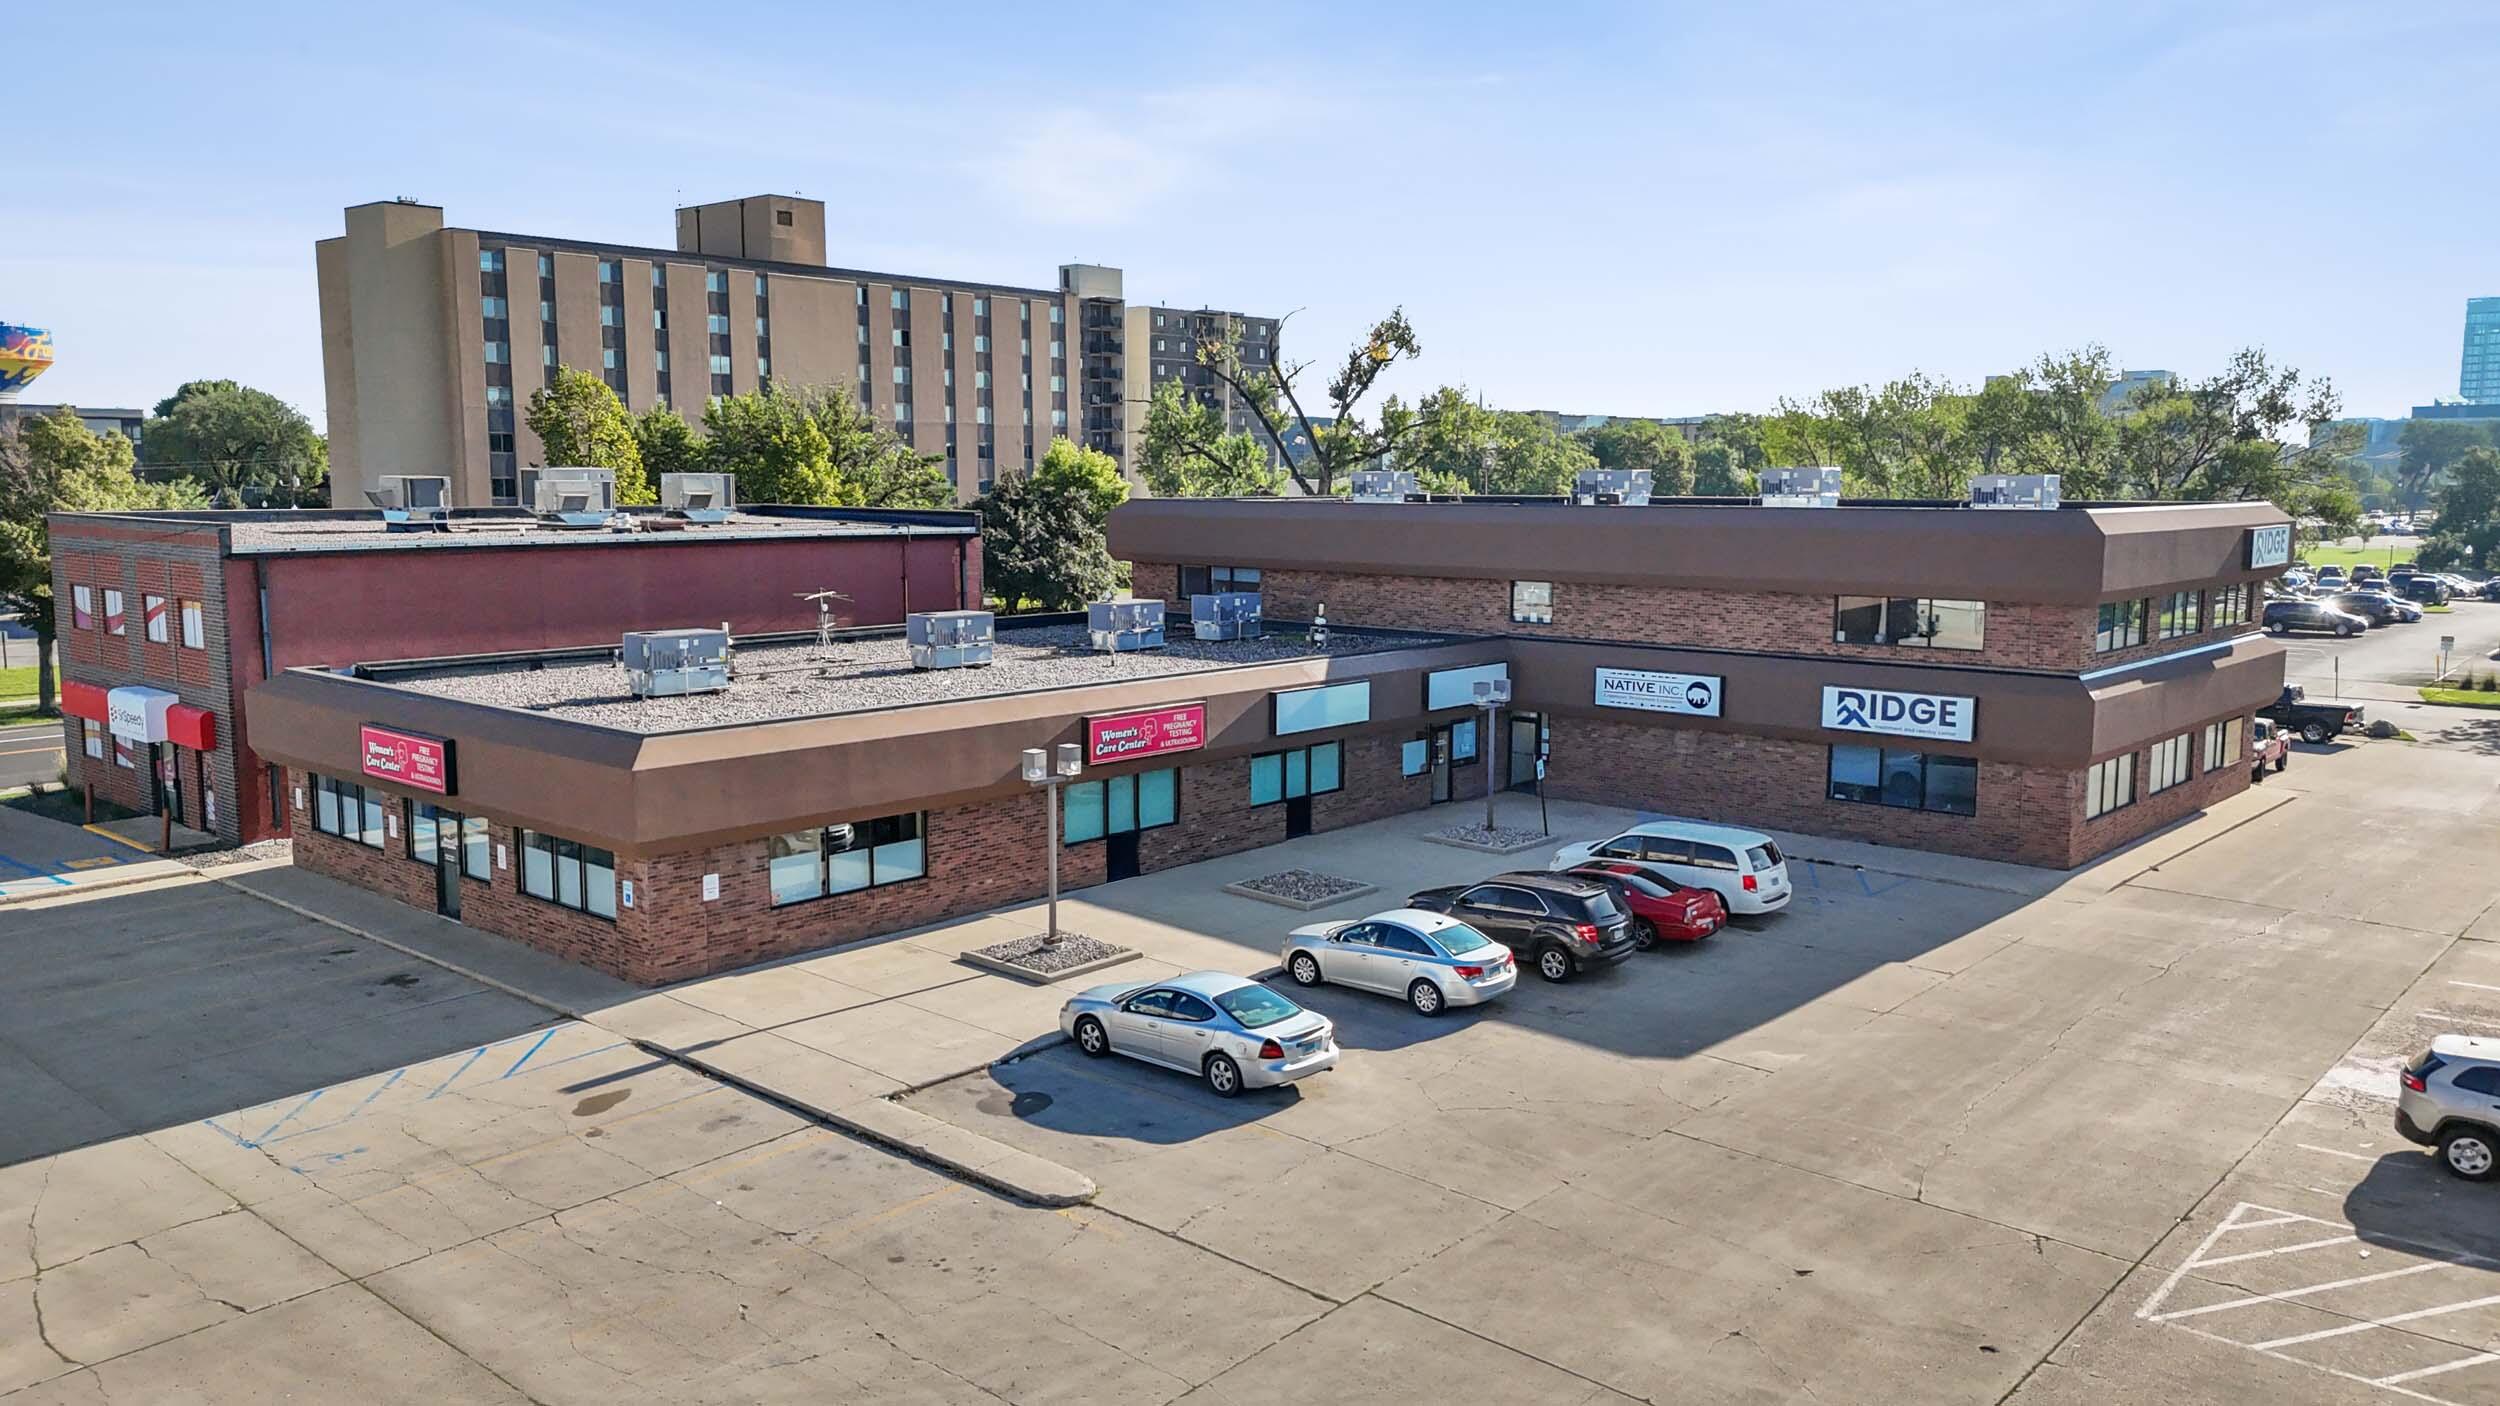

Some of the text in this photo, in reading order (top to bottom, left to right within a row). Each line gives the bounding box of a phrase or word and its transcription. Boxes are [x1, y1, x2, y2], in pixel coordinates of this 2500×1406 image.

[2256, 530, 2286, 564] RIDGE
[1604, 679, 1684, 696] NATIVE INC.
[1173, 713, 1187, 721] FREE
[1837, 691, 1958, 728] RIDGE
[1163, 720, 1197, 731] PREGNANCY
[1169, 728, 1193, 738] TESTING
[1101, 727, 1138, 742] Women's
[368, 741, 394, 757] Women's
[419, 746, 430, 755] FREE
[1096, 740, 1147, 756] Care Center
[366, 754, 400, 772] Care Center
[411, 753, 438, 766] PREGNANCY
[416, 763, 436, 774] TESTING
